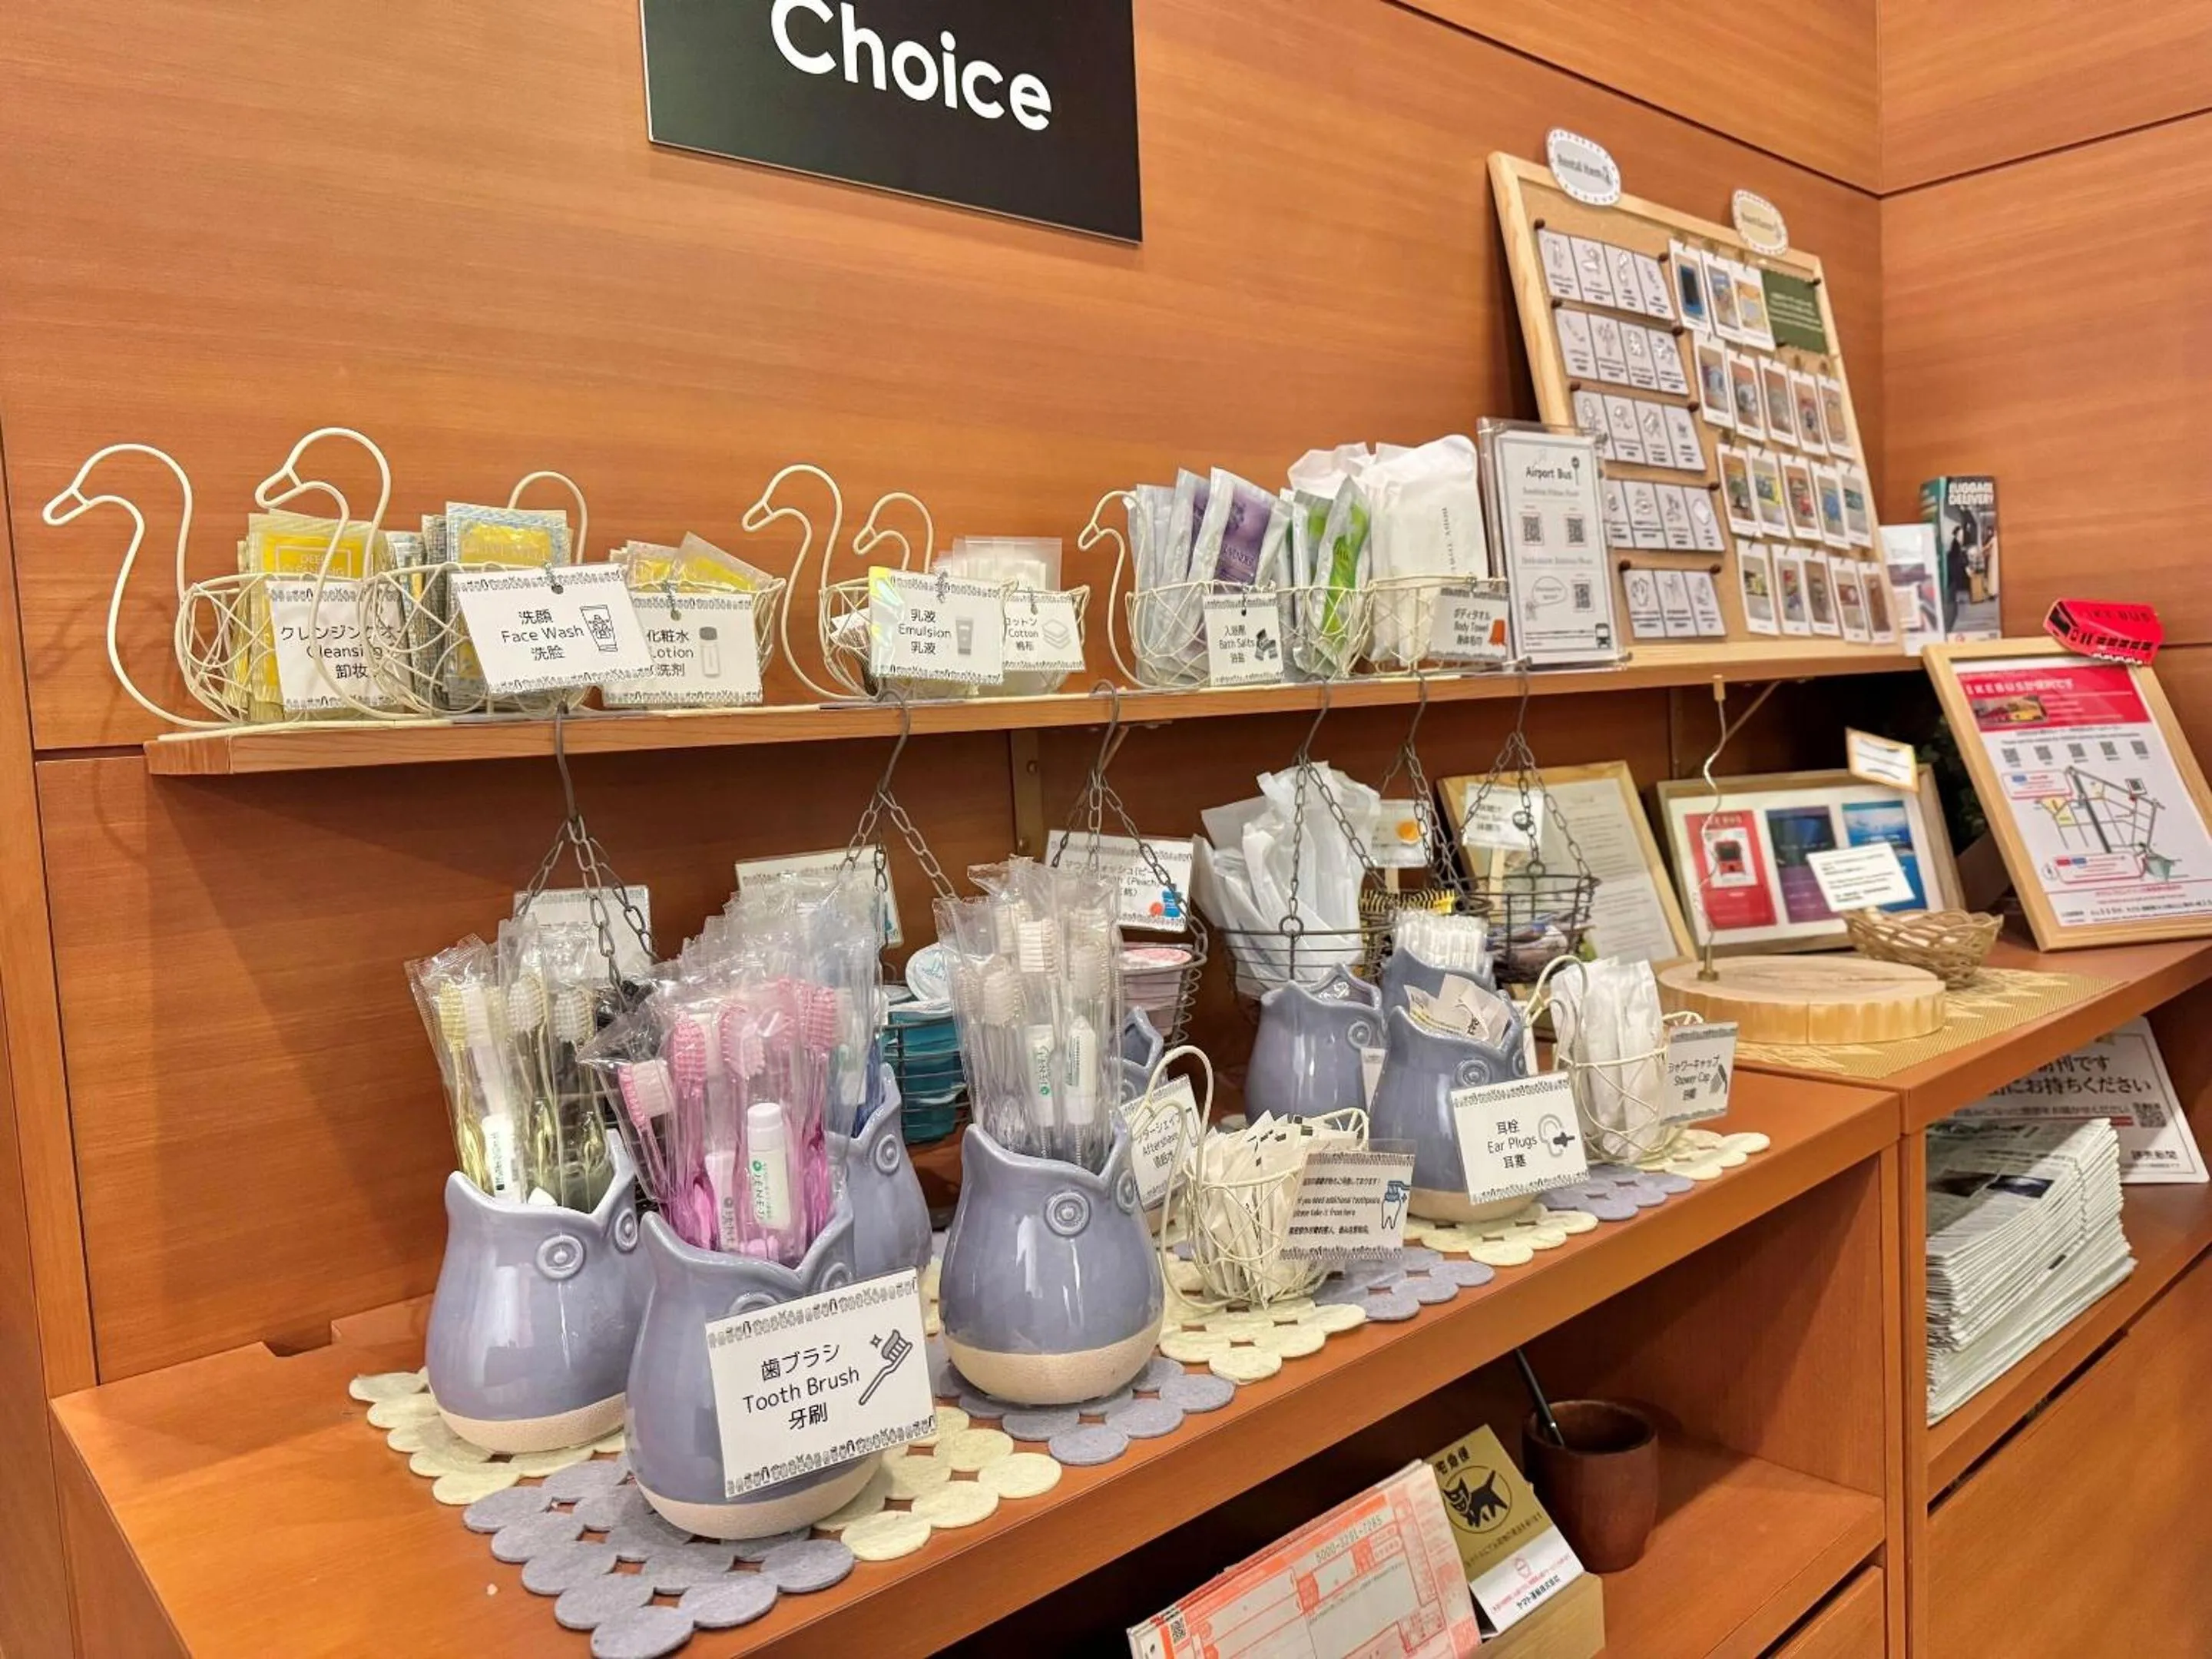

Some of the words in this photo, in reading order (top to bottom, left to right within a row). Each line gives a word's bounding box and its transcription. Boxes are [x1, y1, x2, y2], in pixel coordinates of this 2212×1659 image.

[770, 0, 1052, 131] Choice
[1526, 466, 1555, 481] Airport
[1557, 468, 1572, 479] Bus
[518, 608, 554, 625] 洗顔
[910, 608, 936, 623] 乳液
[501, 628, 538, 644] Face
[541, 624, 584, 641] Wash
[647, 629, 690, 644] 化粧水
[898, 623, 952, 639] Emulsion
[1008, 628, 1039, 638] Cotton
[306, 644, 384, 661] Cleansig
[531, 644, 565, 661] 洗脸
[910, 641, 936, 655] 乳液
[1219, 639, 1236, 650] Bath
[1237, 638, 1256, 648] Salts
[1487, 1141, 1505, 1154] Ear
[1508, 1136, 1538, 1150] Plugs
[760, 1343, 841, 1382] 歯ブラシ
[743, 1383, 802, 1414] Tooth
[806, 1366, 860, 1396] Brush
[788, 1402, 829, 1431] 牙刷
